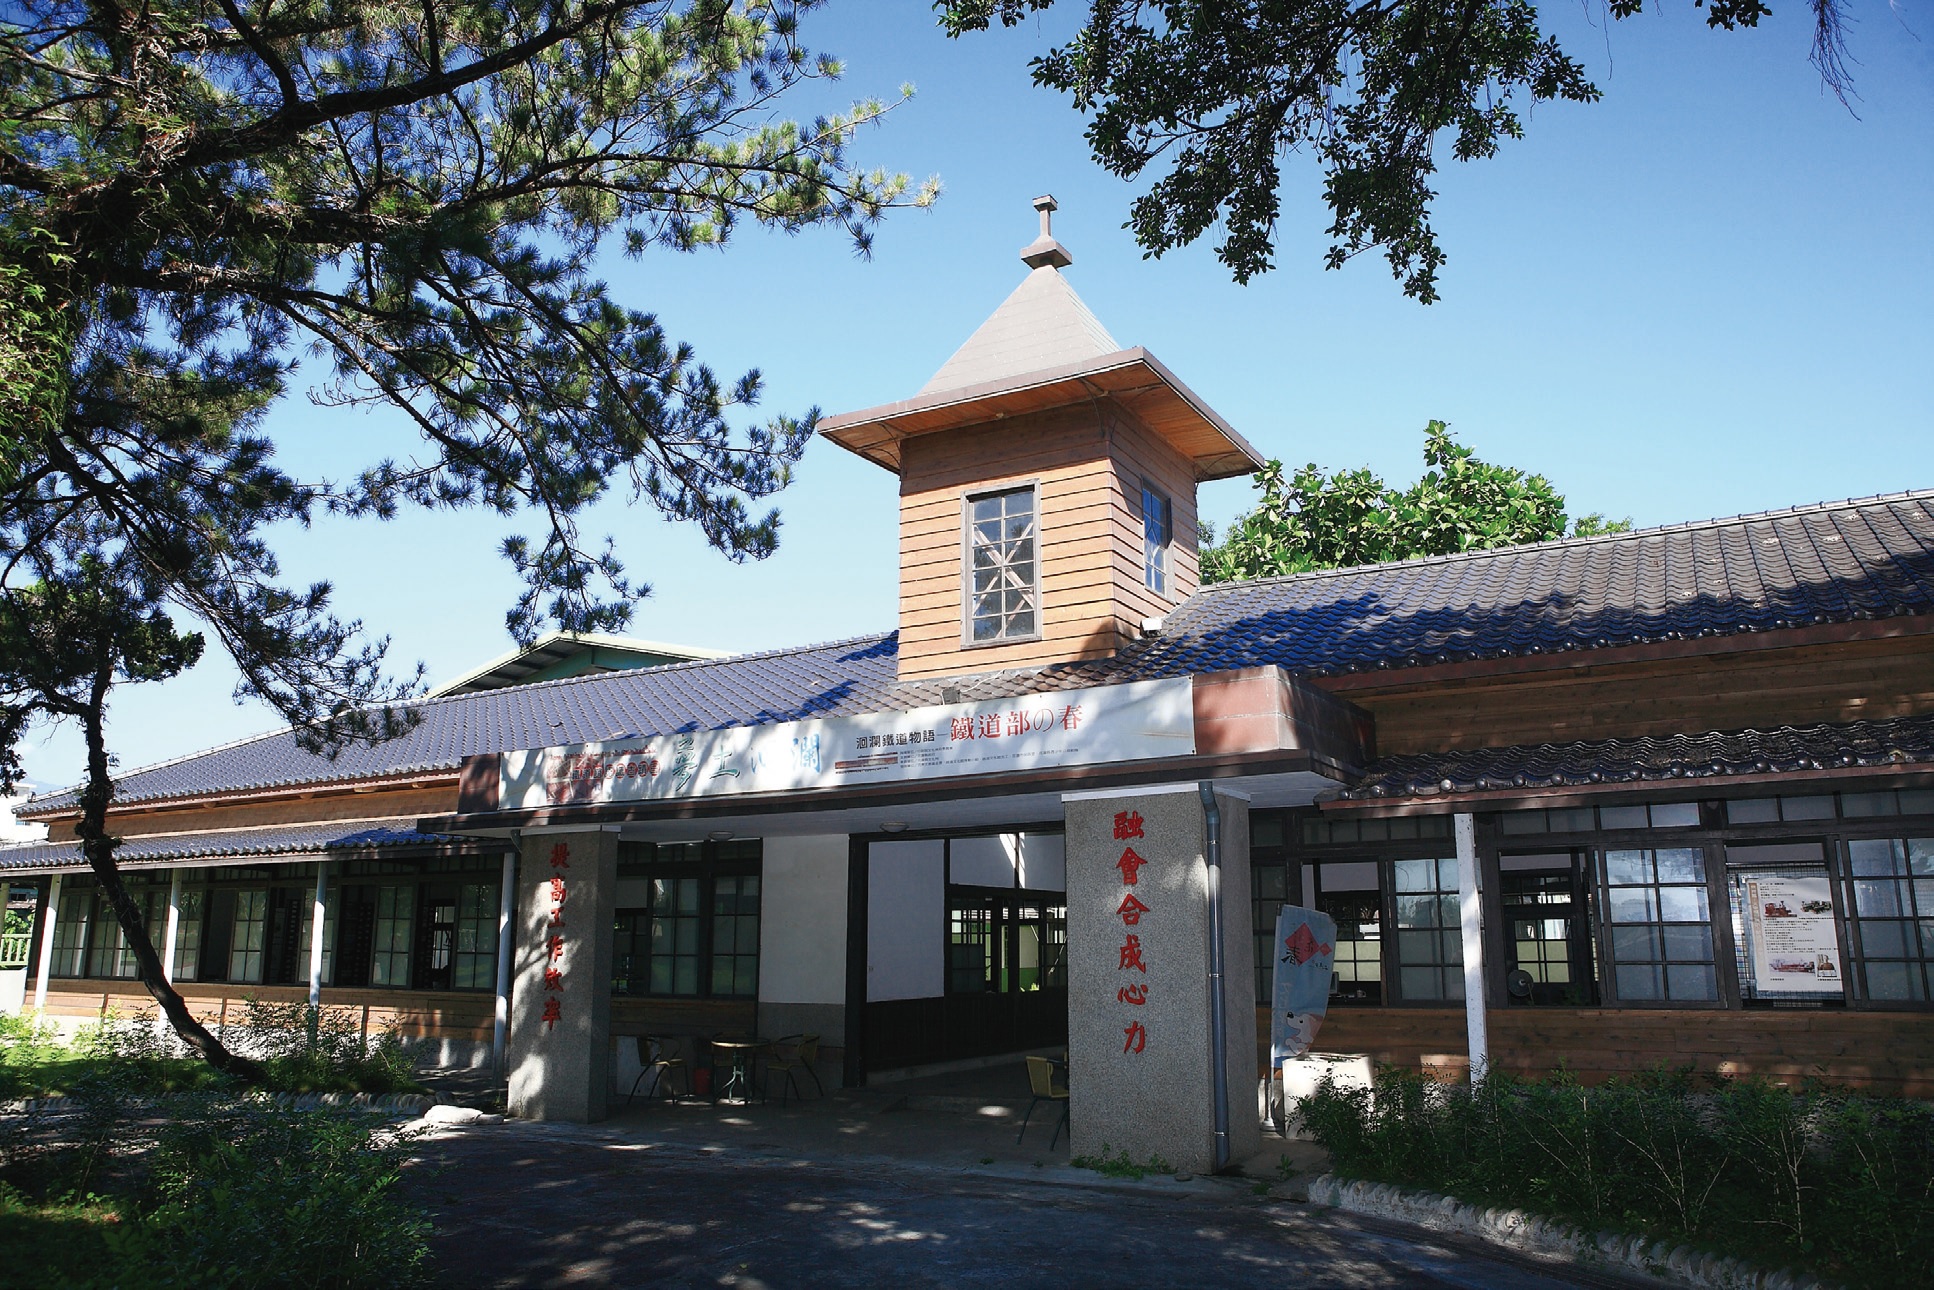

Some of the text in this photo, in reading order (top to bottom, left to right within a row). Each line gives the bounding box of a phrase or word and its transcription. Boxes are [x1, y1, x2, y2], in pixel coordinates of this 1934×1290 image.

[672, 732, 821, 792] 夢土瀾
[950, 704, 1083, 742] 鐵道部の春
[541, 842, 570, 1031] 提高工作效率
[1112, 810, 1150, 1055] 融會合成心力
